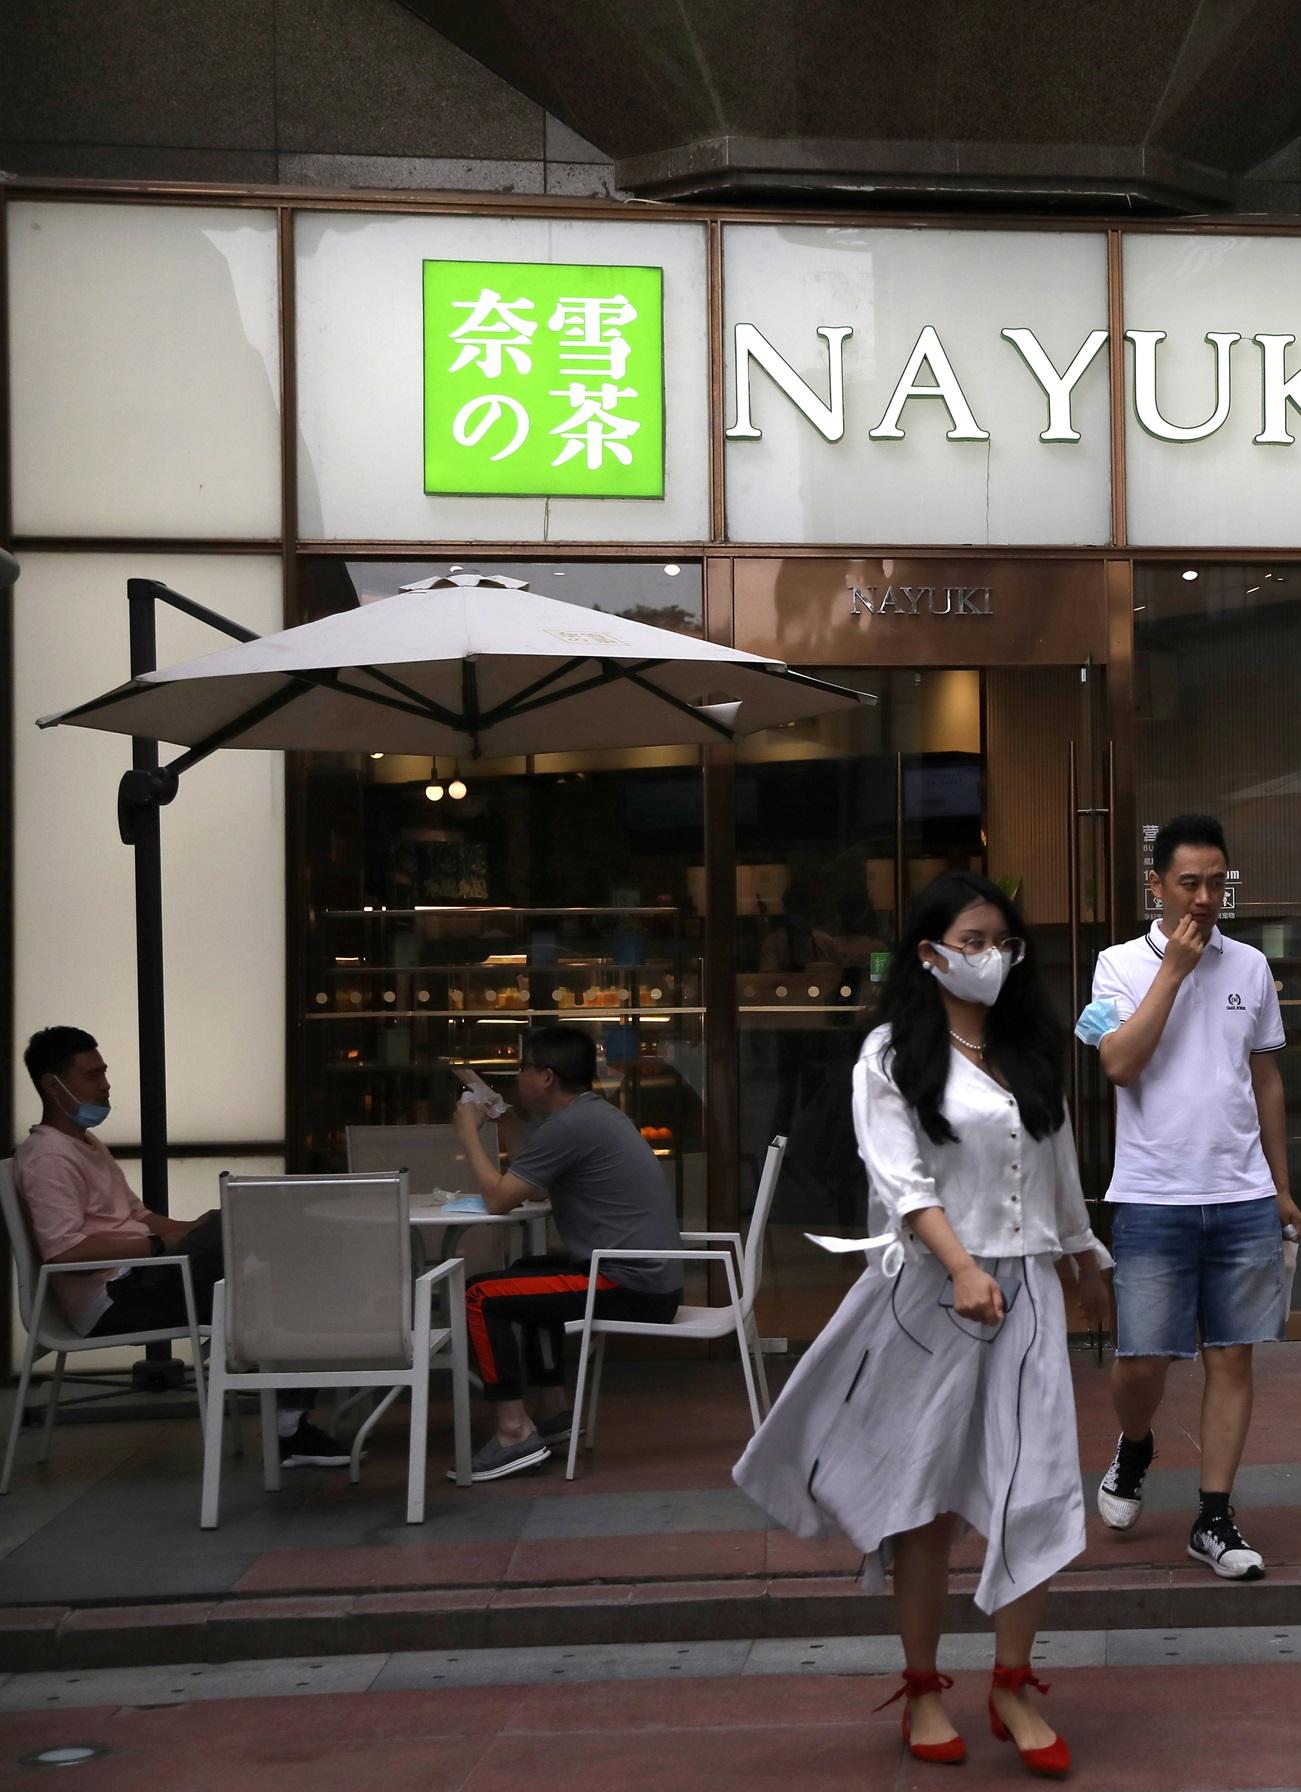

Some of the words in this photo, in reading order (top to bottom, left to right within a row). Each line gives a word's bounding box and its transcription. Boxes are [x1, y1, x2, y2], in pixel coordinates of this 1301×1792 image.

[448, 287, 639, 380] 奈雪
[452, 382, 641, 471] の茶
[848, 586, 994, 615] NAYUKI
